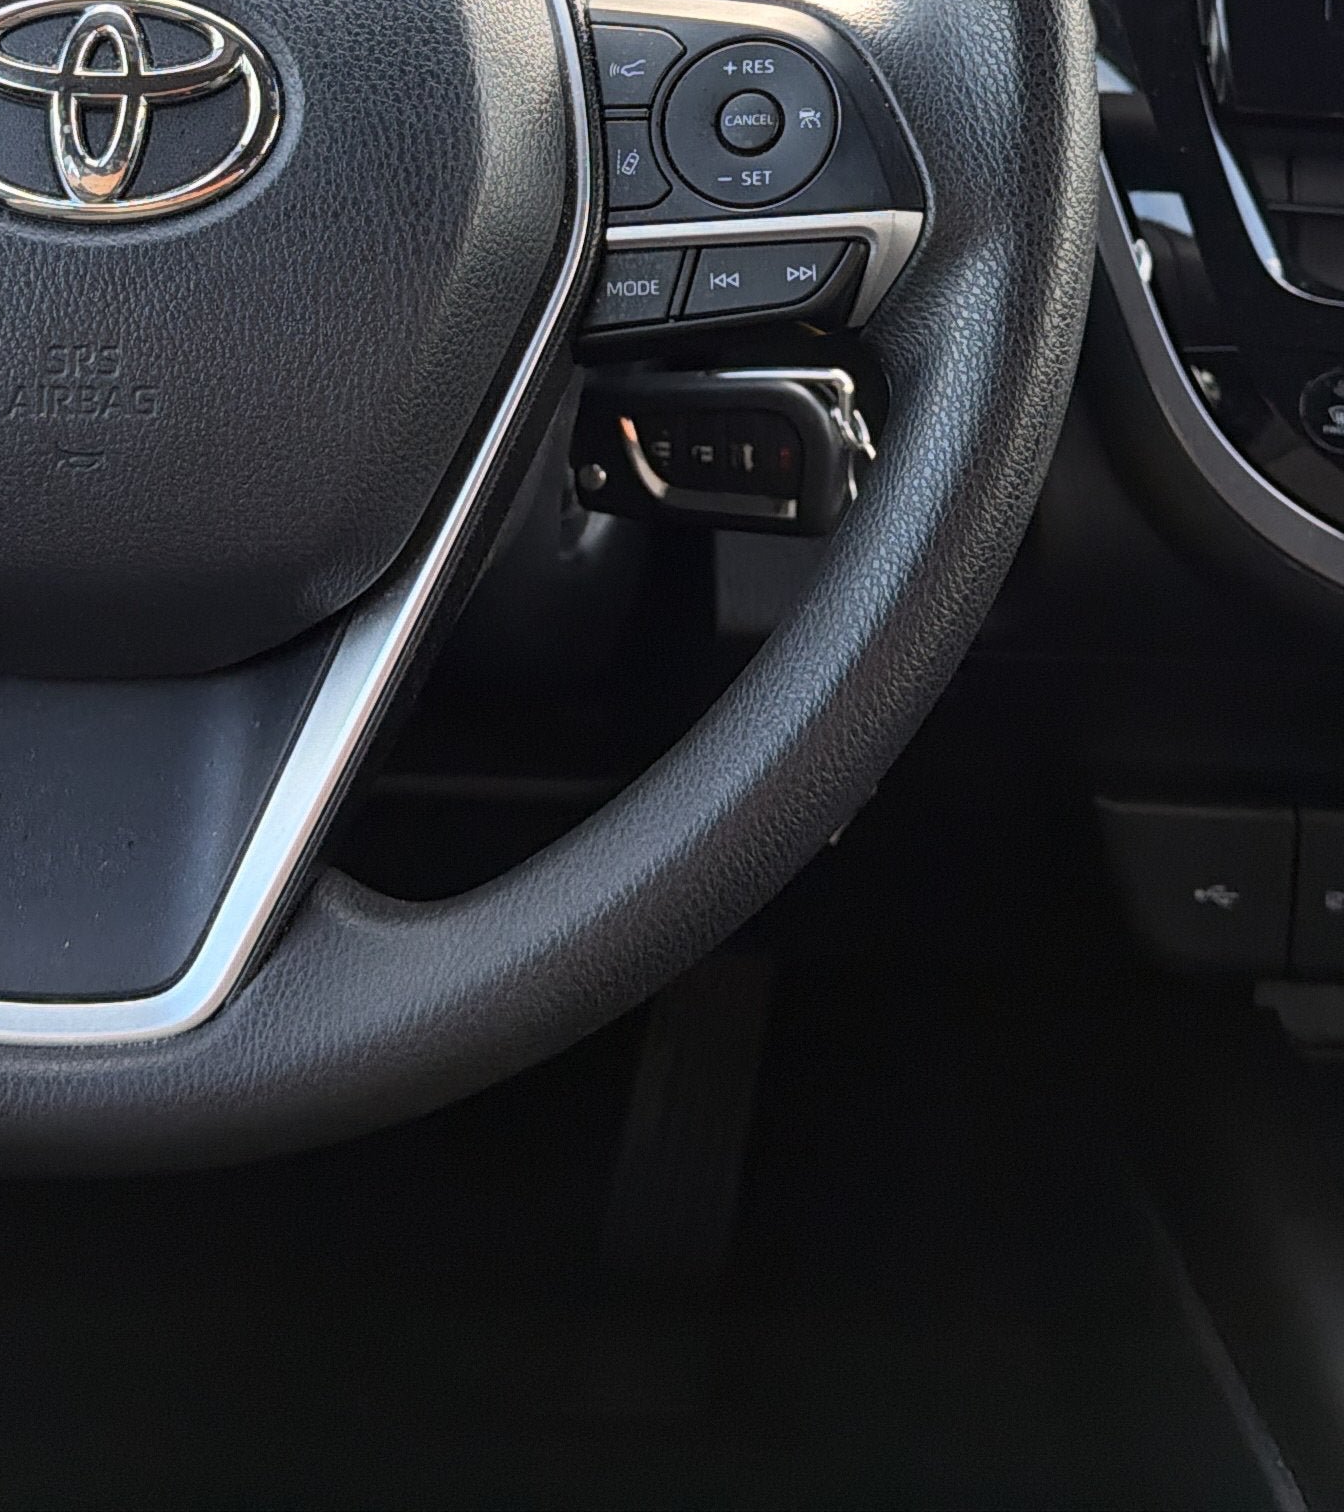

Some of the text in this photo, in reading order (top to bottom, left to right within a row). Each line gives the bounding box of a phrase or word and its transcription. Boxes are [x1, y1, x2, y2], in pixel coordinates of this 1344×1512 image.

[742, 59, 774, 74] RES
[725, 114, 773, 127] CANCEL
[741, 171, 773, 186] SET
[606, 279, 660, 296] MODE
[47, 345, 120, 377] SRS
[6, 386, 158, 417] AIRBAG
